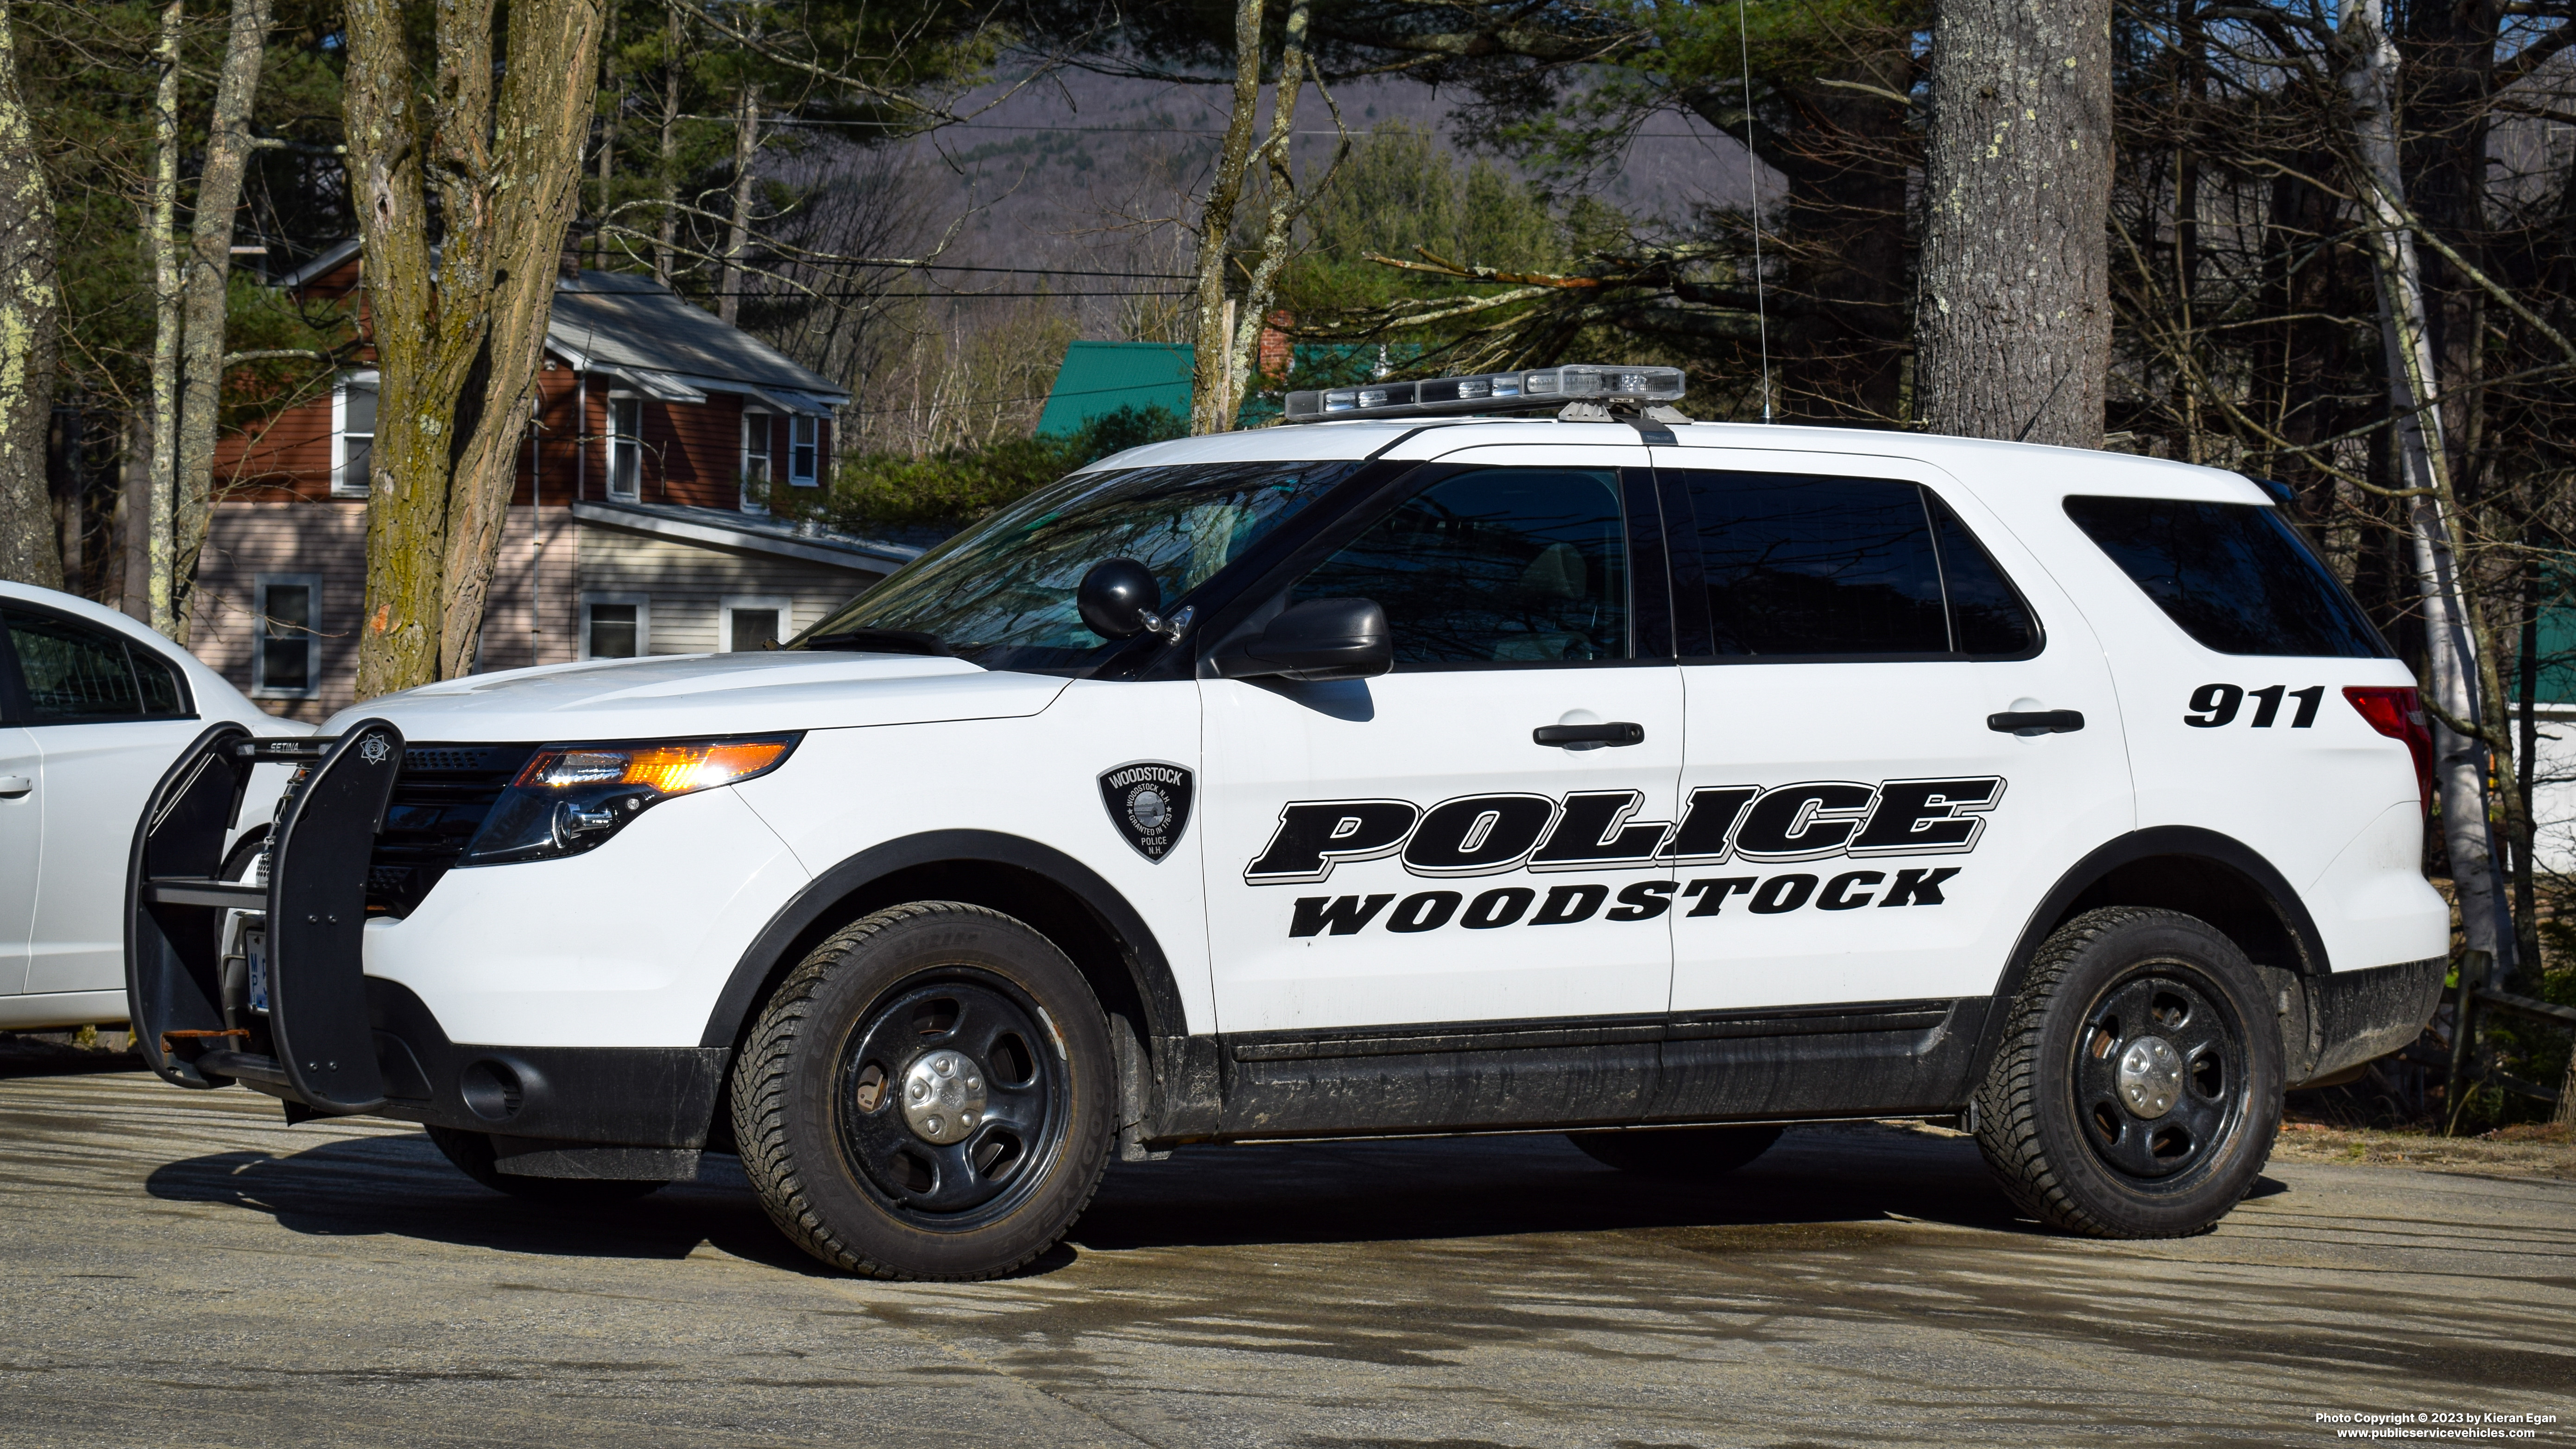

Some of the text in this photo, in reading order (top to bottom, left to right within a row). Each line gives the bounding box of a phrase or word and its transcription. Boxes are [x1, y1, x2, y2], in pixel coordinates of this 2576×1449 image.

[2184, 683, 2325, 728] 911
[271, 742, 299, 753] SETINA
[1109, 767, 1183, 789] WOODSTOCK
[1127, 783, 1170, 806] WOODSTOCK N.H.
[1129, 815, 1155, 836] GRANTED
[1162, 813, 1172, 829] 1763
[1243, 775, 2008, 887] POLICE
[1141, 836, 1167, 845] POLICE
[1149, 846, 1163, 855] N.H.
[1289, 867, 1962, 938] WOODSTOCK
